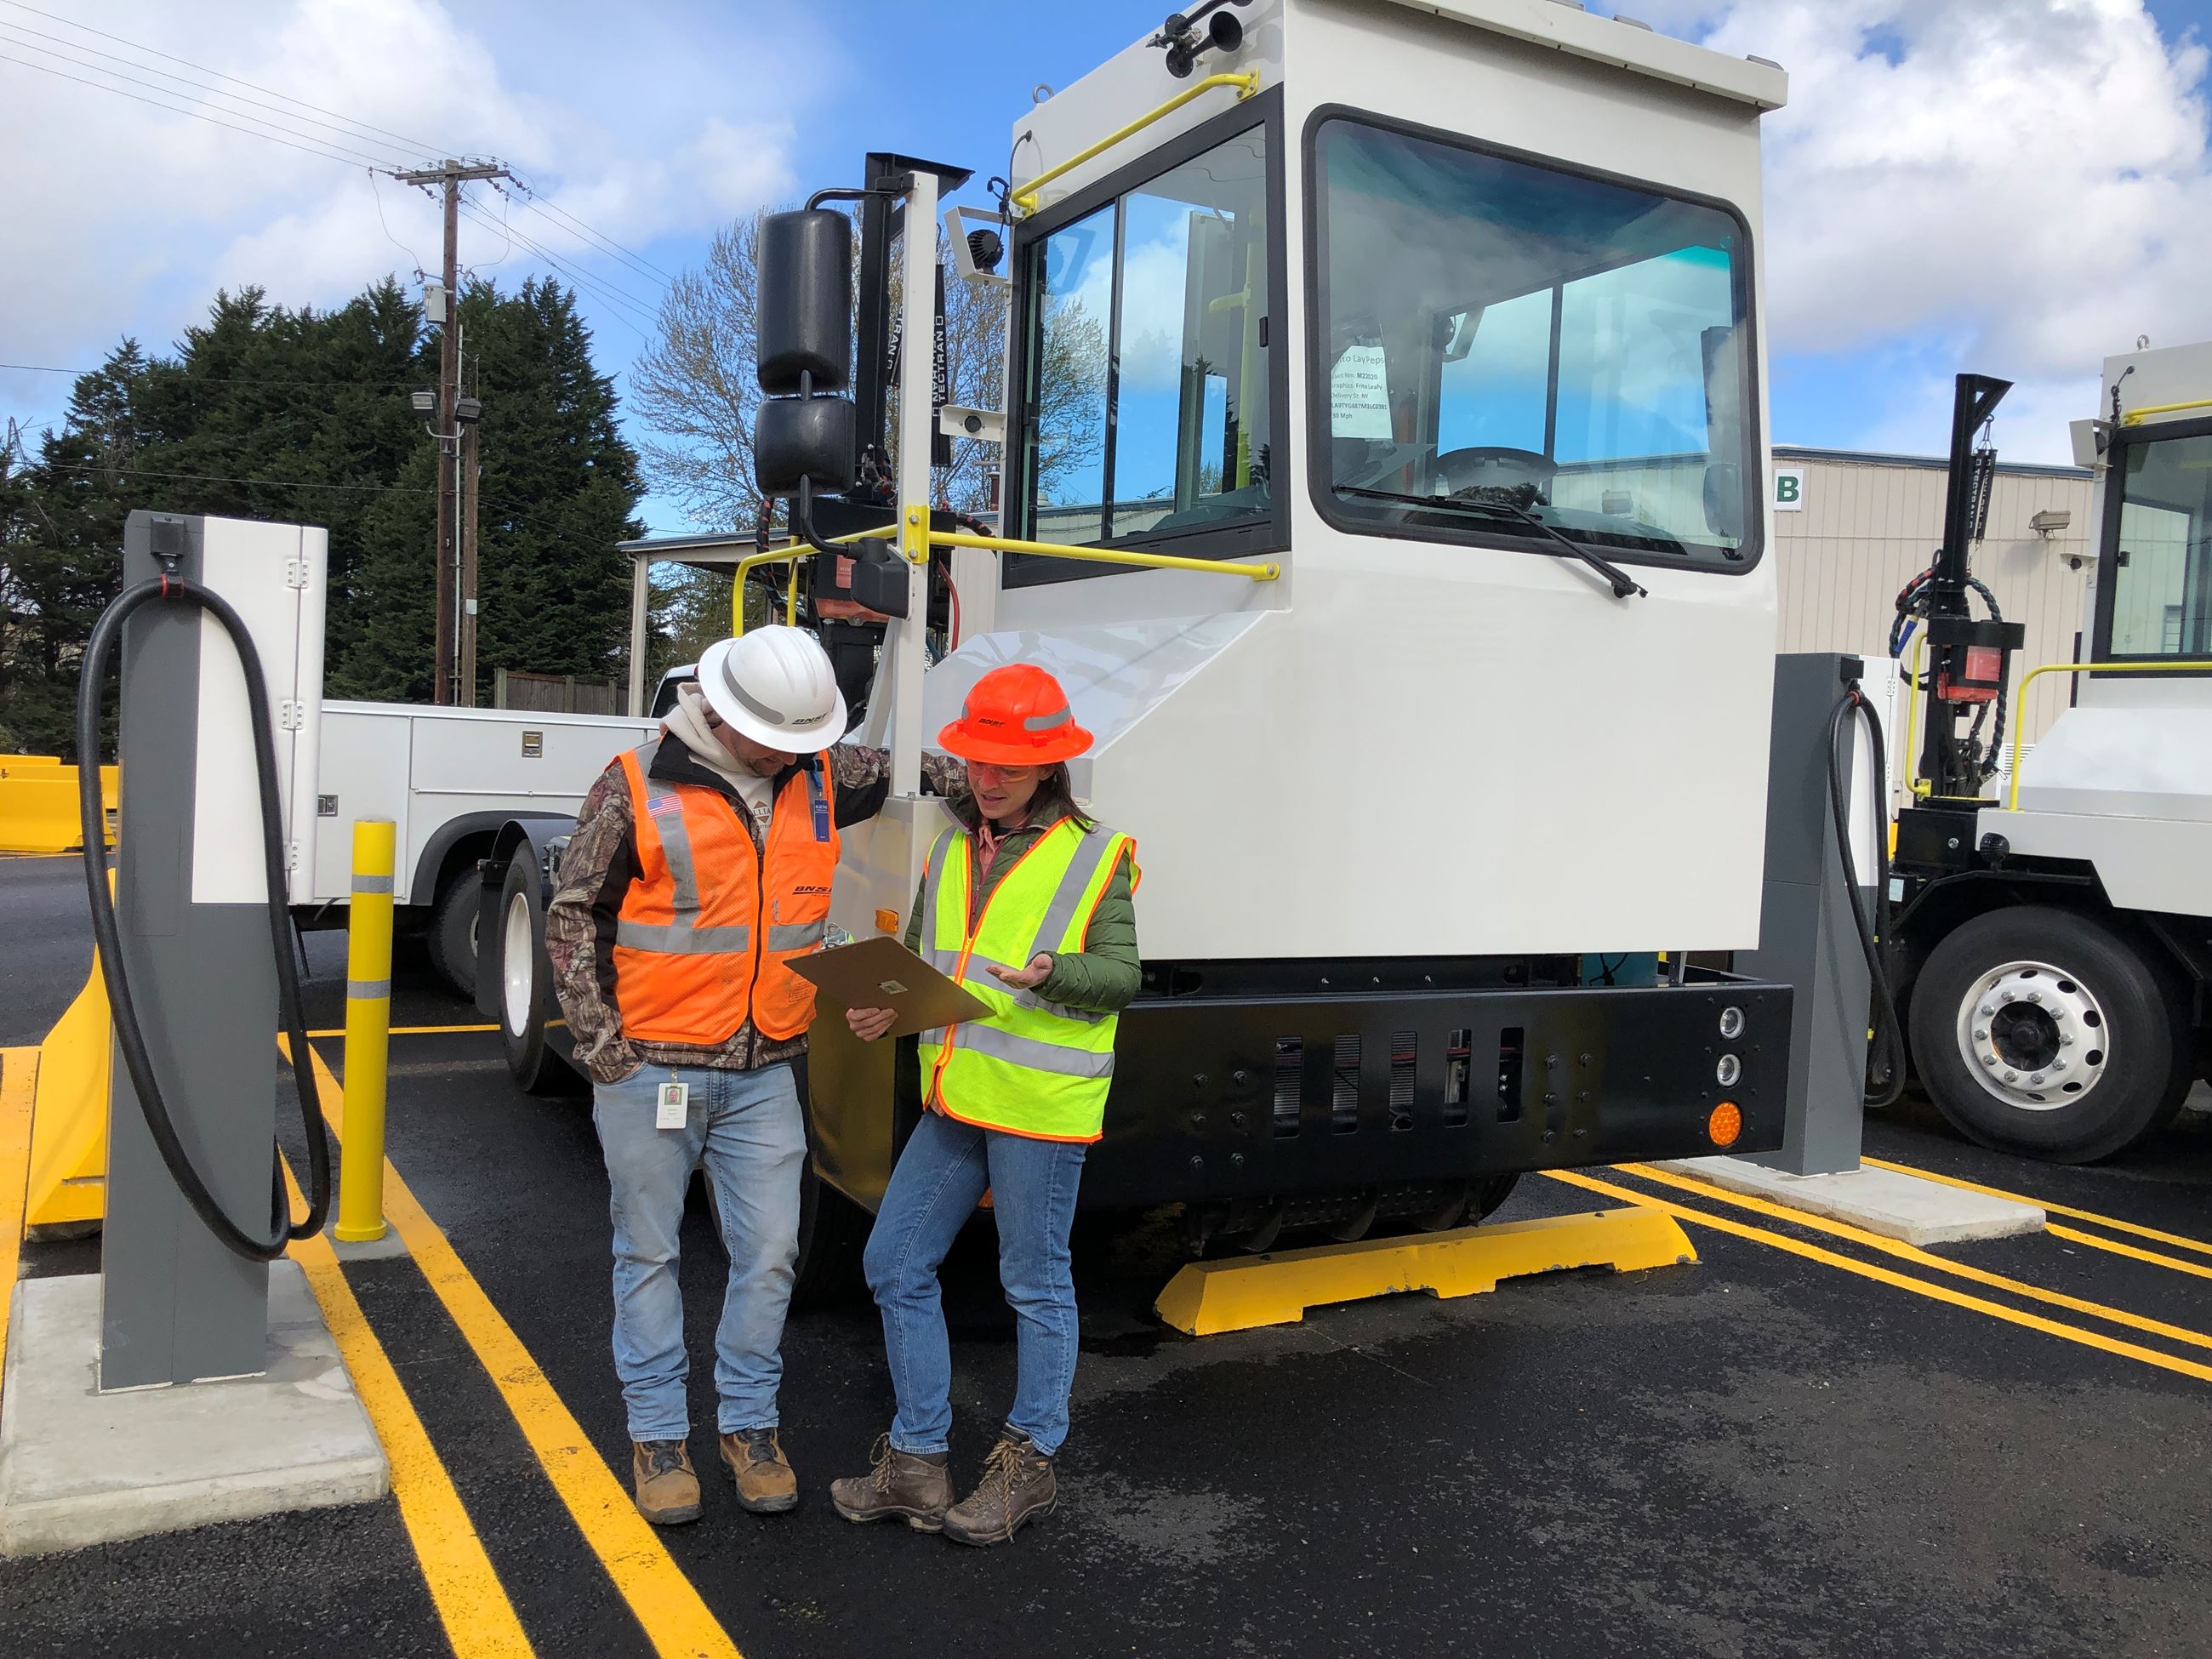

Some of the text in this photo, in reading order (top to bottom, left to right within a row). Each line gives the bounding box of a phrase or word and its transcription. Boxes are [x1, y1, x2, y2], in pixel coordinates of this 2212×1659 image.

[937, 330, 946, 402] TECTRAN
[1777, 476, 1799, 502] B
[794, 712, 829, 723] BNSF
